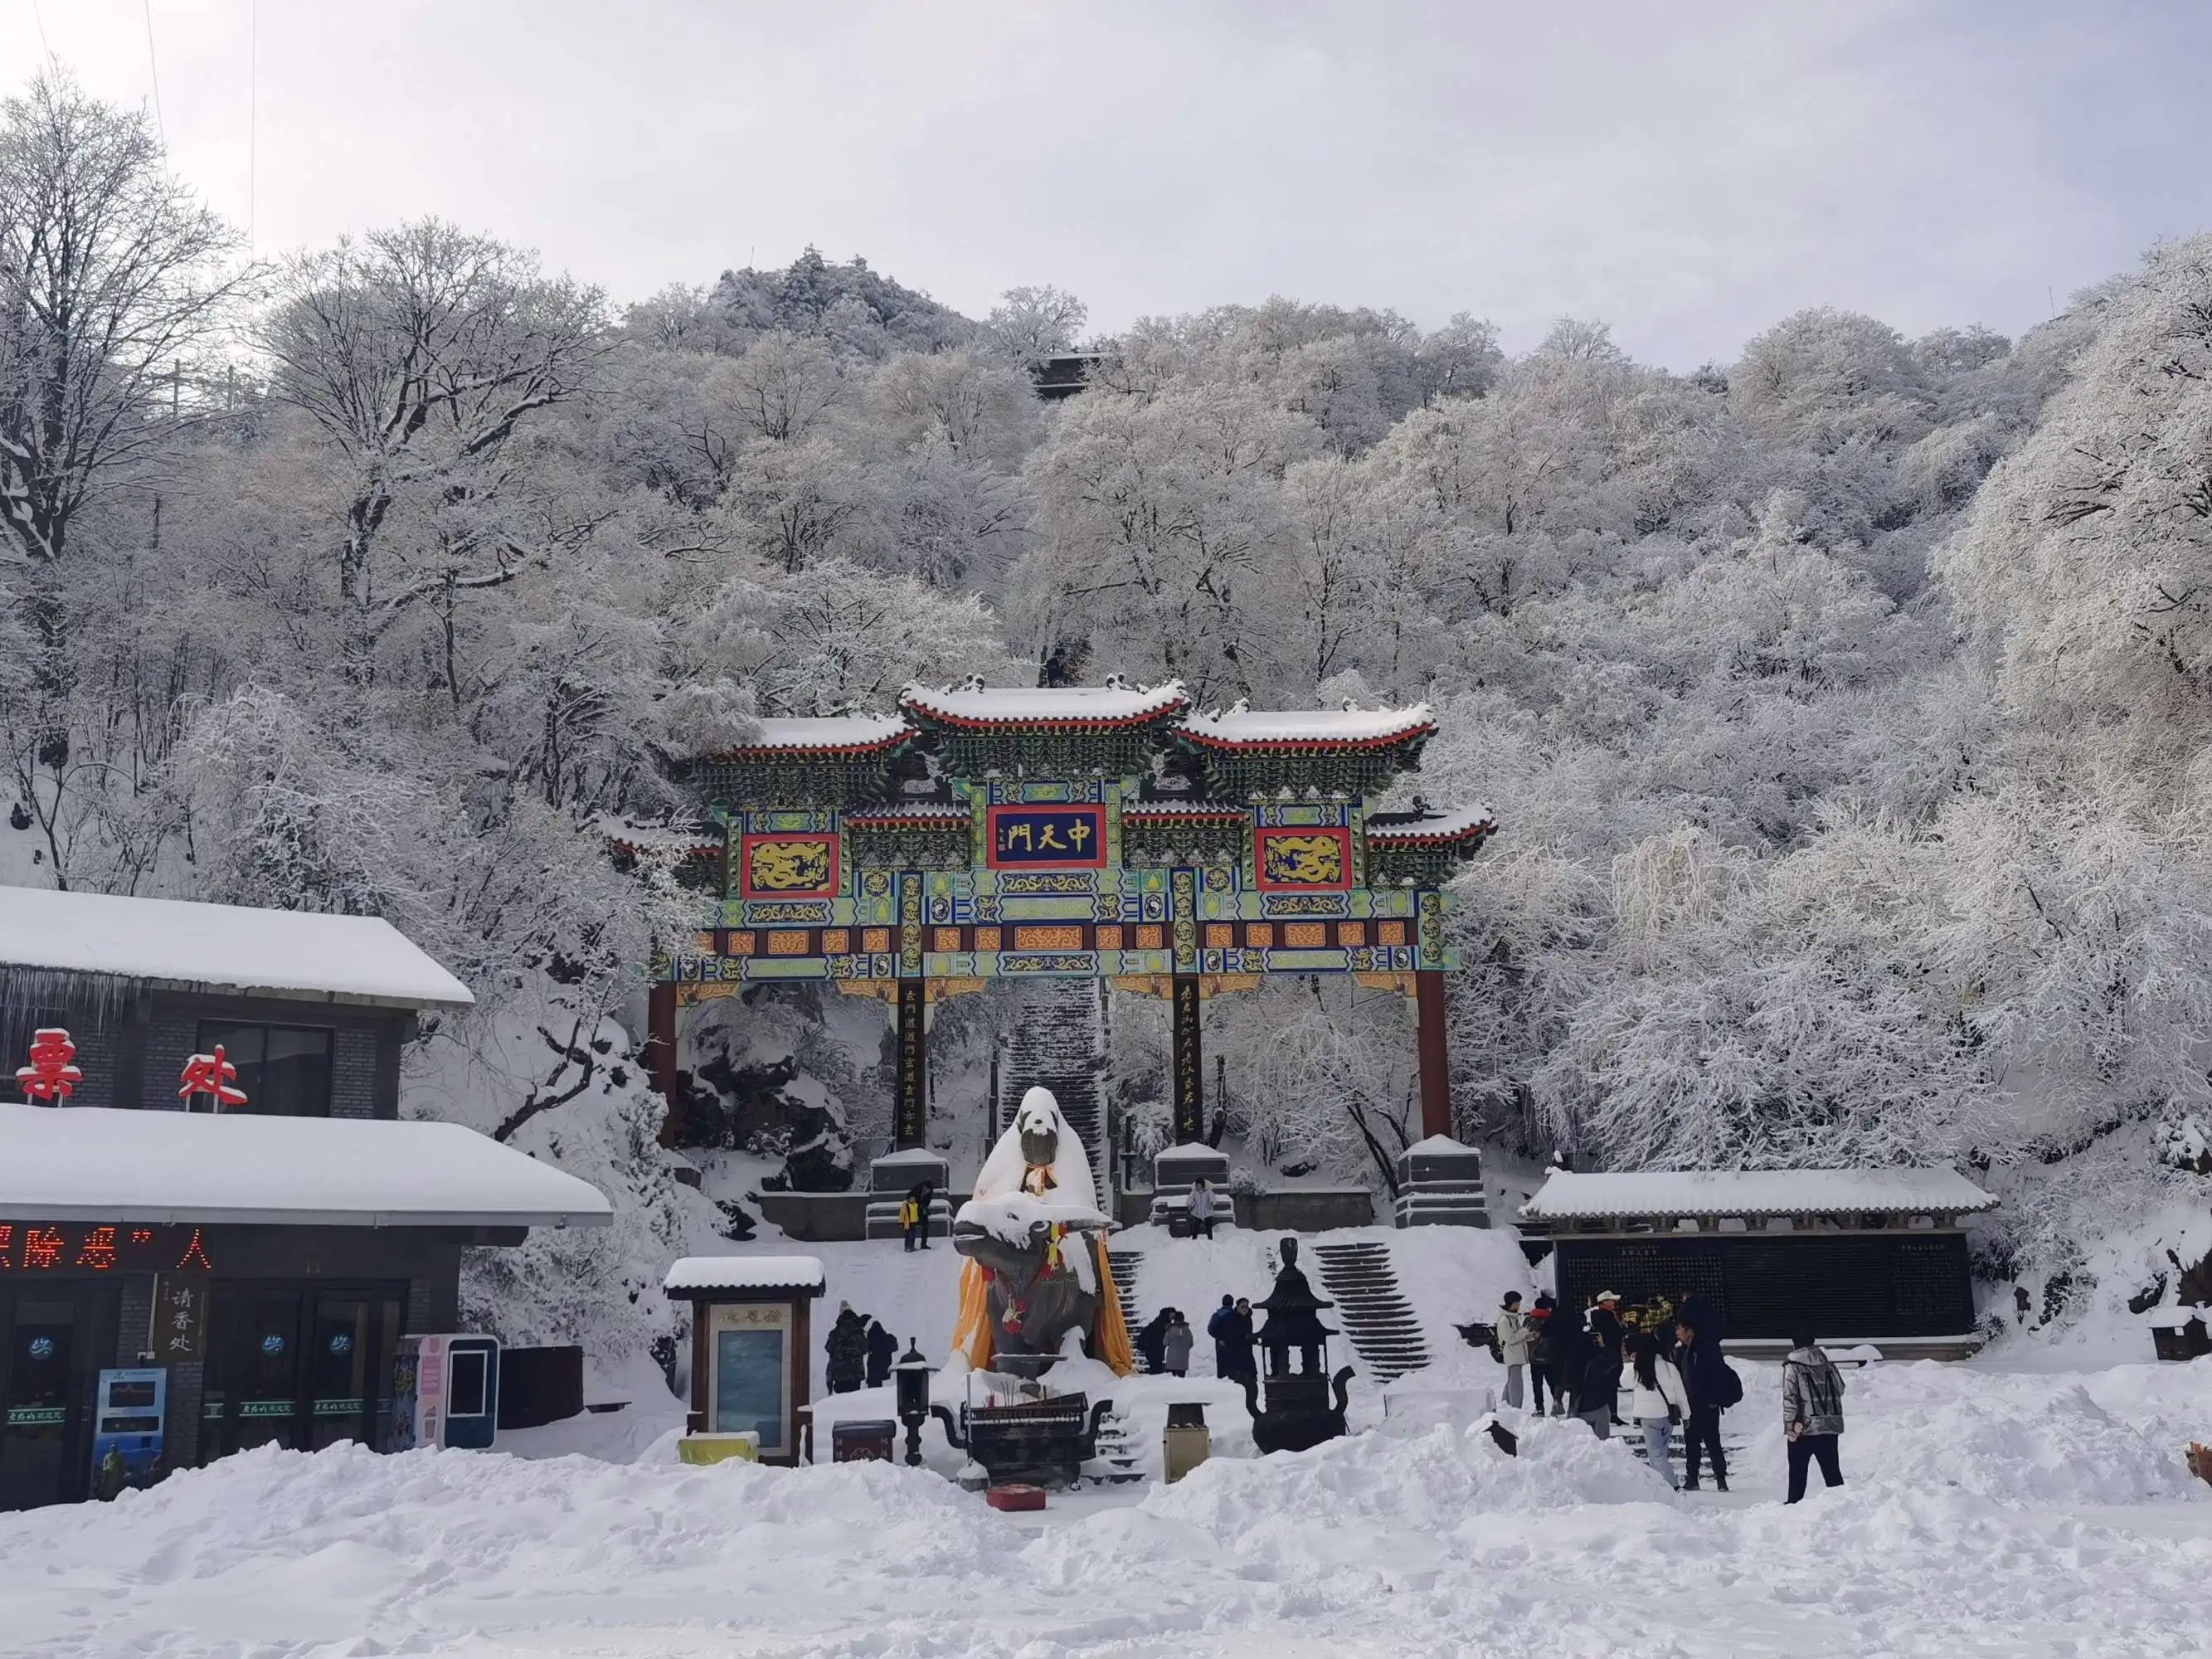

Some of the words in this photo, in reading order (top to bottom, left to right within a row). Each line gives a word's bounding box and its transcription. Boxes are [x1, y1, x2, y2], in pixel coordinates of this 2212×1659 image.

[1008, 819, 1091, 853] 中天門
[168, 1287, 195, 1352] 请香处
